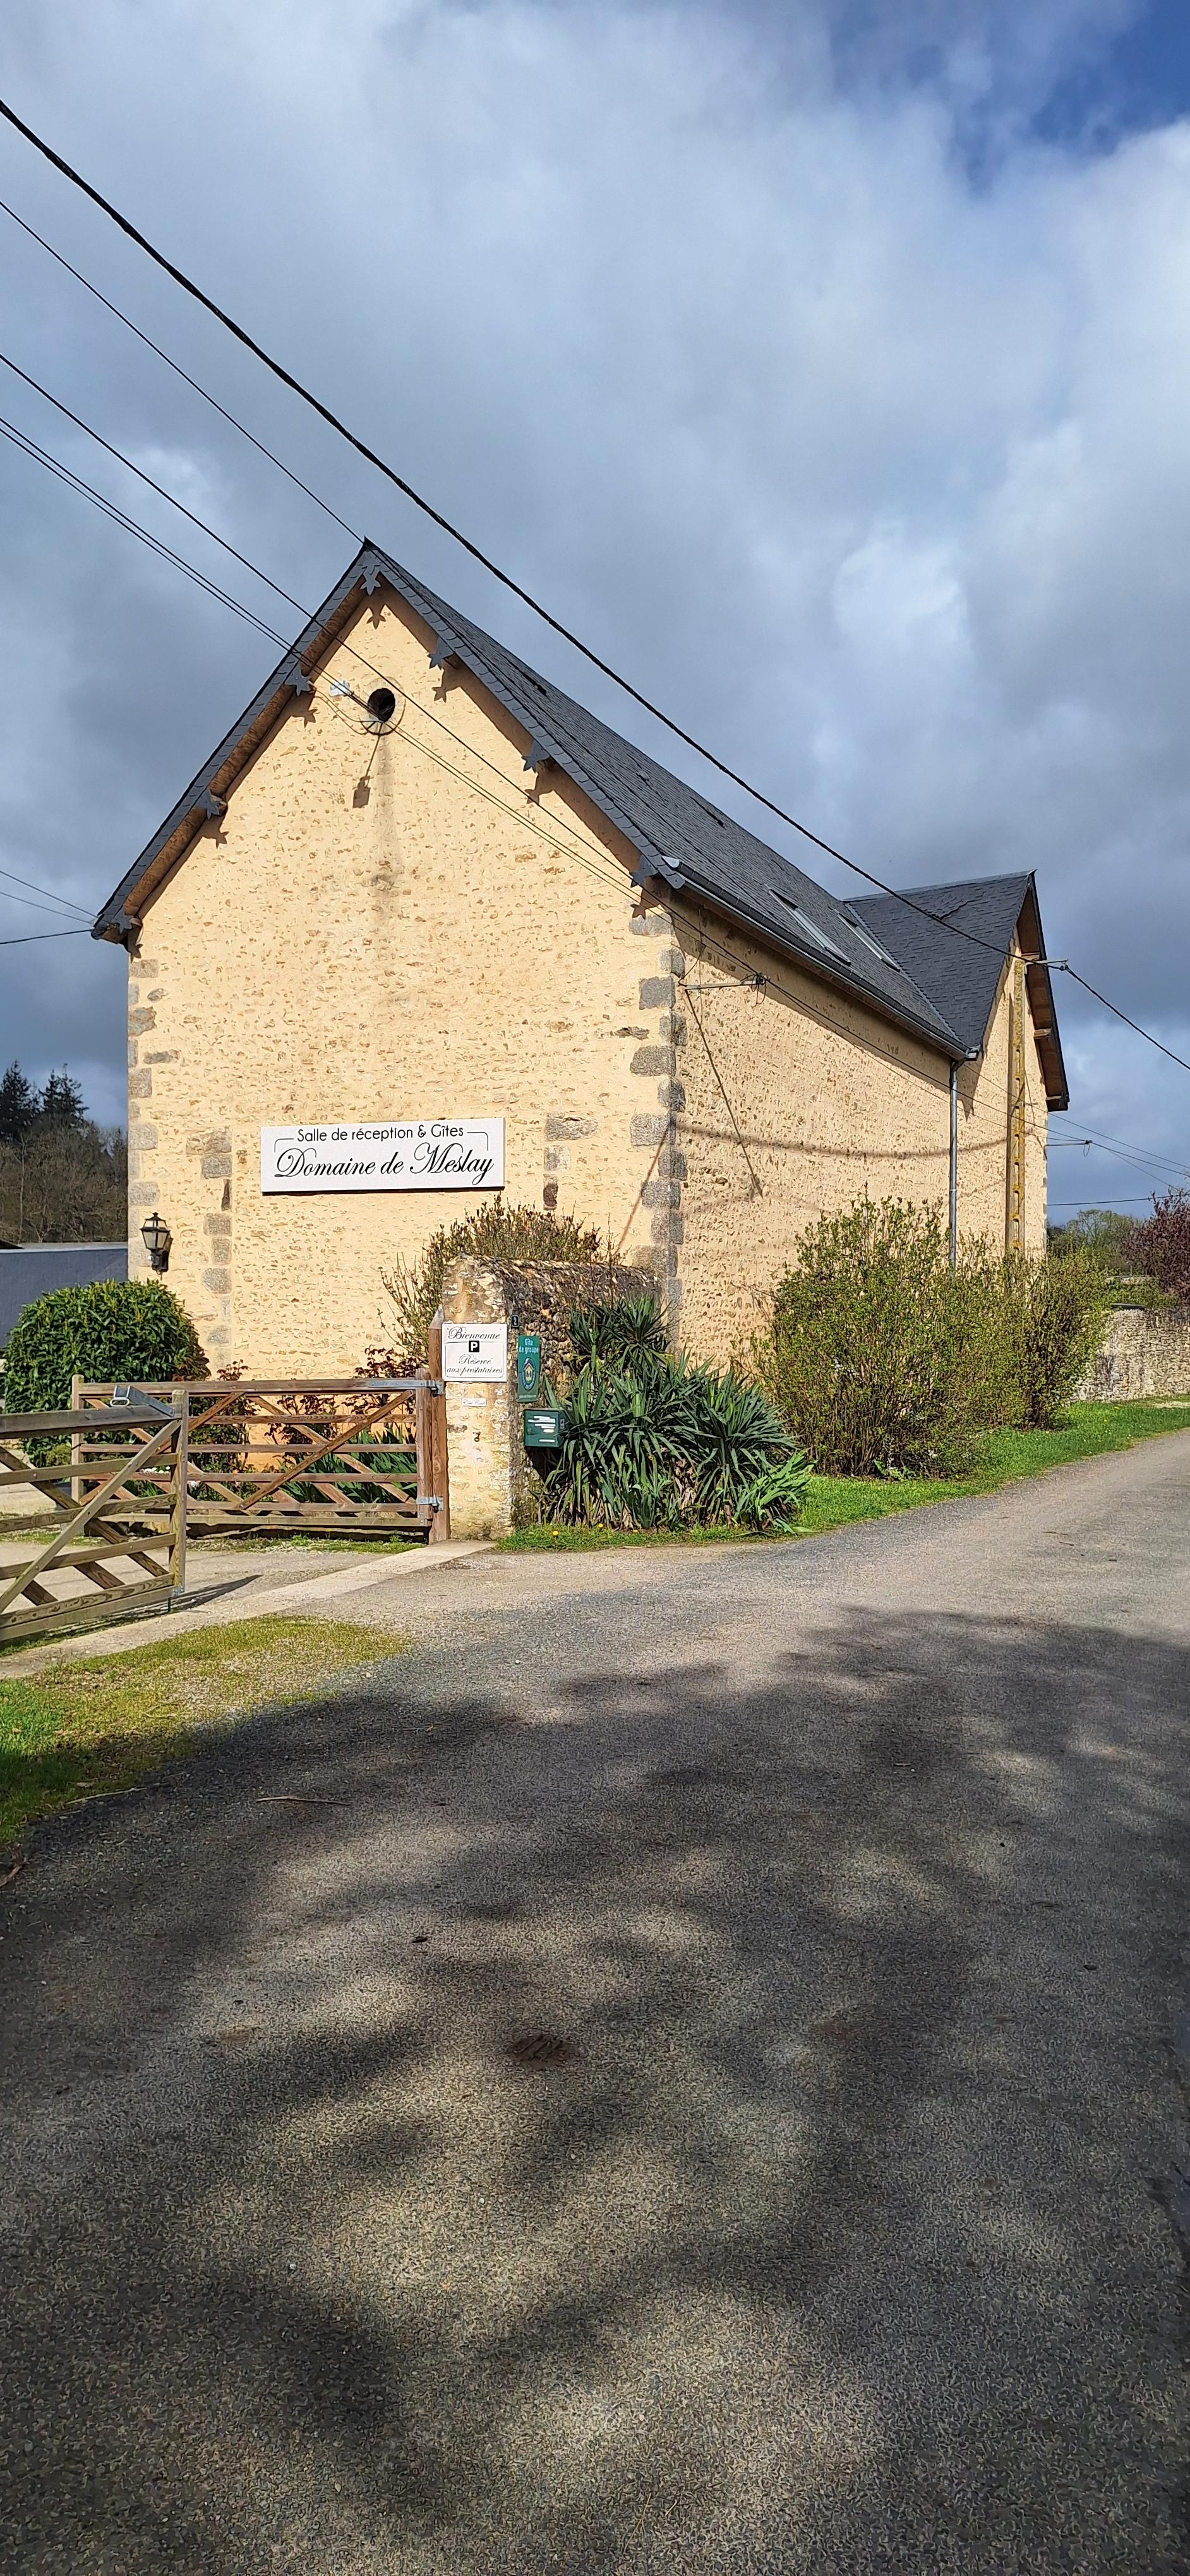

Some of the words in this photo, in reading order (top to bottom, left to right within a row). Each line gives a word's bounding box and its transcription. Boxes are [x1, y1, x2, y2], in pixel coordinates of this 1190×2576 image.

[298, 1128, 327, 1142] Salle
[332, 1127, 348, 1141] de
[352, 1127, 413, 1142] réception
[418, 1124, 426, 1138] &
[431, 1124, 464, 1138] Gîtes
[274, 1147, 376, 1178] Domaine
[380, 1152, 404, 1175] de
[409, 1142, 495, 1186] Meslay
[513, 1316, 517, 1326] 2
[448, 1326, 501, 1340] Bienvenue
[524, 1347, 539, 1355] groupe
[460, 1366, 503, 1376] prestataires
